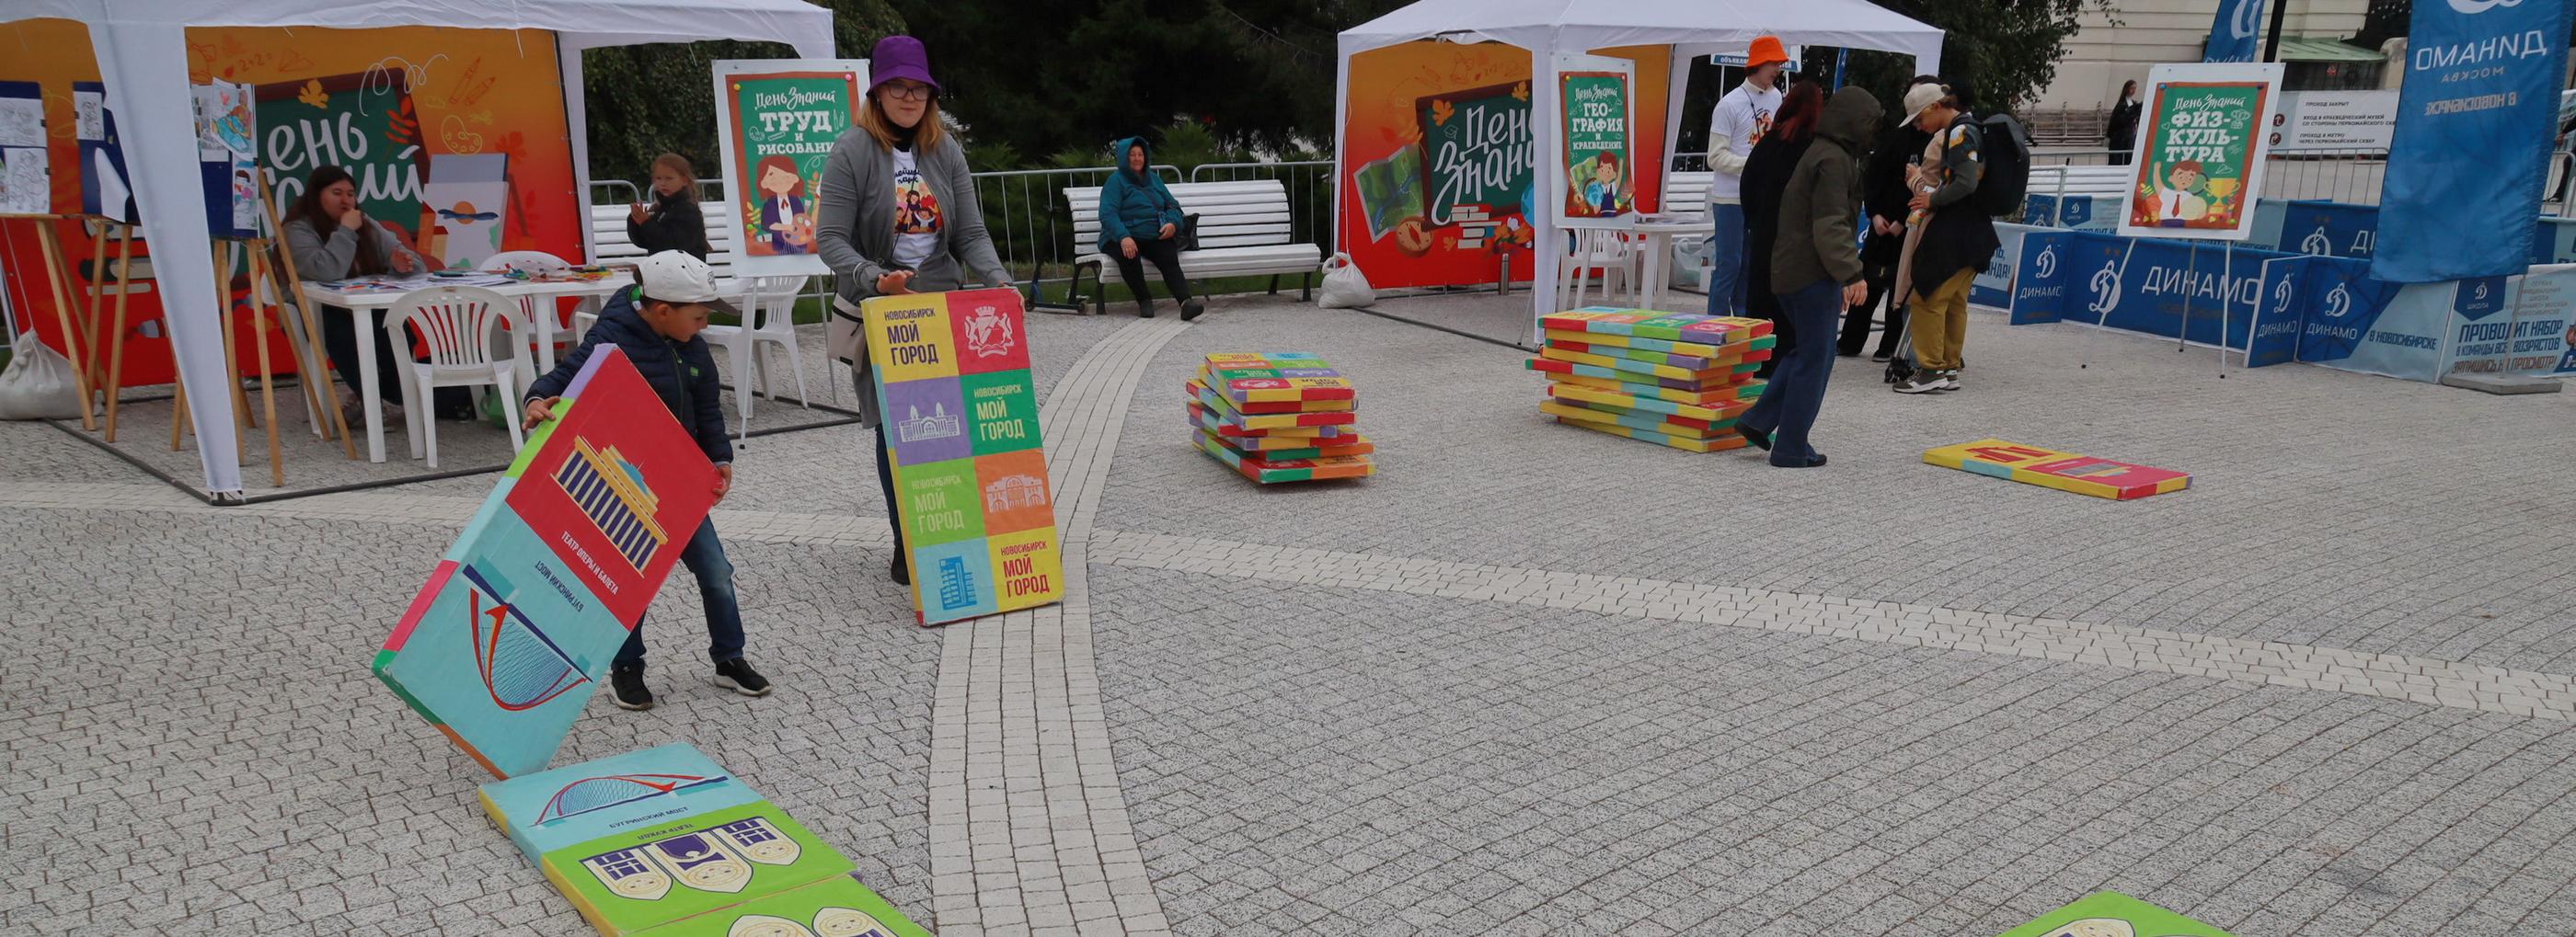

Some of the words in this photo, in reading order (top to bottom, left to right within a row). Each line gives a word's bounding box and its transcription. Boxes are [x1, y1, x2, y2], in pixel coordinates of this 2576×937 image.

[1720, 56, 1749, 65] объявл
[754, 91, 788, 111] День
[787, 86, 836, 110] Знаний
[1574, 87, 1593, 102] День
[1591, 84, 1619, 102] Знаний
[2172, 97, 2202, 111] День
[2200, 94, 2247, 111] Знаний
[1583, 103, 1613, 117] ГЕО-
[2171, 111, 2231, 128] ФИЗ-
[759, 110, 833, 132] ТРУД
[1572, 118, 1623, 132] ГРАФИЯ
[268, 111, 368, 172] ень
[1572, 141, 1622, 150] КРАЕВЕДЕНИЕ
[2167, 129, 2239, 145] КУЛЬ-
[757, 143, 835, 155] РИСОВАНИ
[2165, 146, 2225, 163] ТУРА
[2142, 266, 2260, 304] ДИНАМО
[884, 306, 936, 321] НОВОСИБИРСК
[887, 320, 920, 345] МОЙ
[2257, 320, 2297, 338] ДИНАМО
[2306, 323, 2358, 340] ДИНАМО
[2530, 319, 2564, 337] НАБОР
[2369, 331, 2375, 342] В
[2376, 332, 2438, 351] НОВОСИБИРСКЕ
[2461, 343, 2494, 357] КОМАНДЫ
[2494, 341, 2509, 355] ВСЕ
[2513, 337, 2561, 353] ВОЗРАСТОВ
[890, 343, 939, 367] ГОРОД
[2452, 358, 2497, 374] ЗАПИШИСЬ
[2512, 355, 2558, 369] ПРОСМОТР!
[973, 383, 1022, 398] НОВОСИБИРСК
[976, 396, 1007, 421] МОЙ
[979, 418, 1025, 441] ГОРОД
[912, 474, 962, 491] НОВОСИБИРСК
[914, 487, 947, 514] МОЙ
[919, 509, 965, 534] ГОРОД
[1001, 540, 1048, 556] НОВОСИБИРСК
[535, 560, 552, 579] МОСТ
[561, 530, 580, 552] ТЕАТР
[576, 547, 596, 571] ОПЕРЫ
[597, 571, 619, 595] БАЛЕТА
[1003, 554, 1033, 578] МОЙ
[548, 572, 584, 612] БУГРИНСКИЙ
[1006, 574, 1051, 599] ГОРОД
[609, 812, 665, 828] БУГРИНСКИЙ
[665, 806, 688, 815] МОСТ
[668, 823, 695, 833] ТЕАТР
